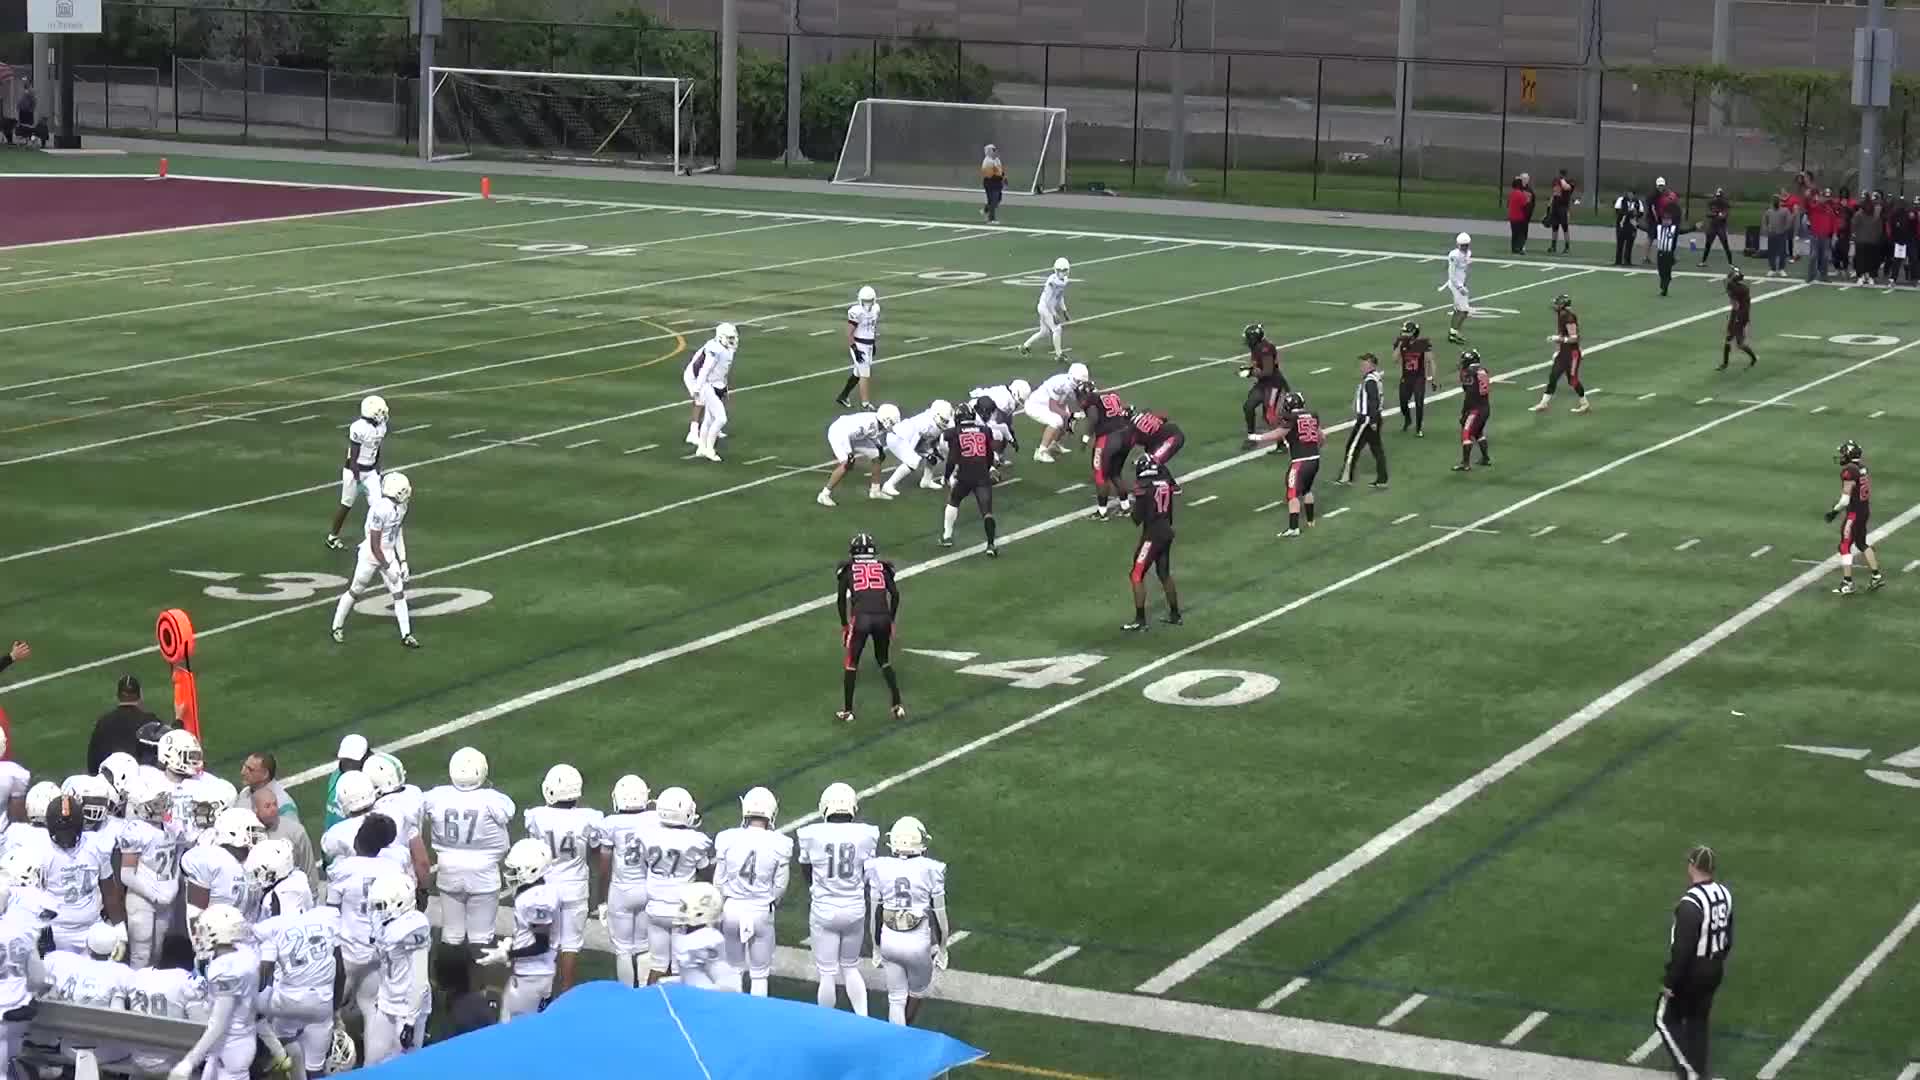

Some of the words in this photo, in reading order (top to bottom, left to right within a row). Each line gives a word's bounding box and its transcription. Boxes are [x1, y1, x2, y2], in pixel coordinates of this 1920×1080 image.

[959, 432, 987, 457] 58
[852, 563, 886, 591] 35
[444, 808, 479, 845] 67
[545, 830, 577, 860] 14
[648, 846, 681, 876] 27
[824, 843, 856, 880] 18
[738, 850, 757, 886] 4
[286, 924, 328, 968] 25
